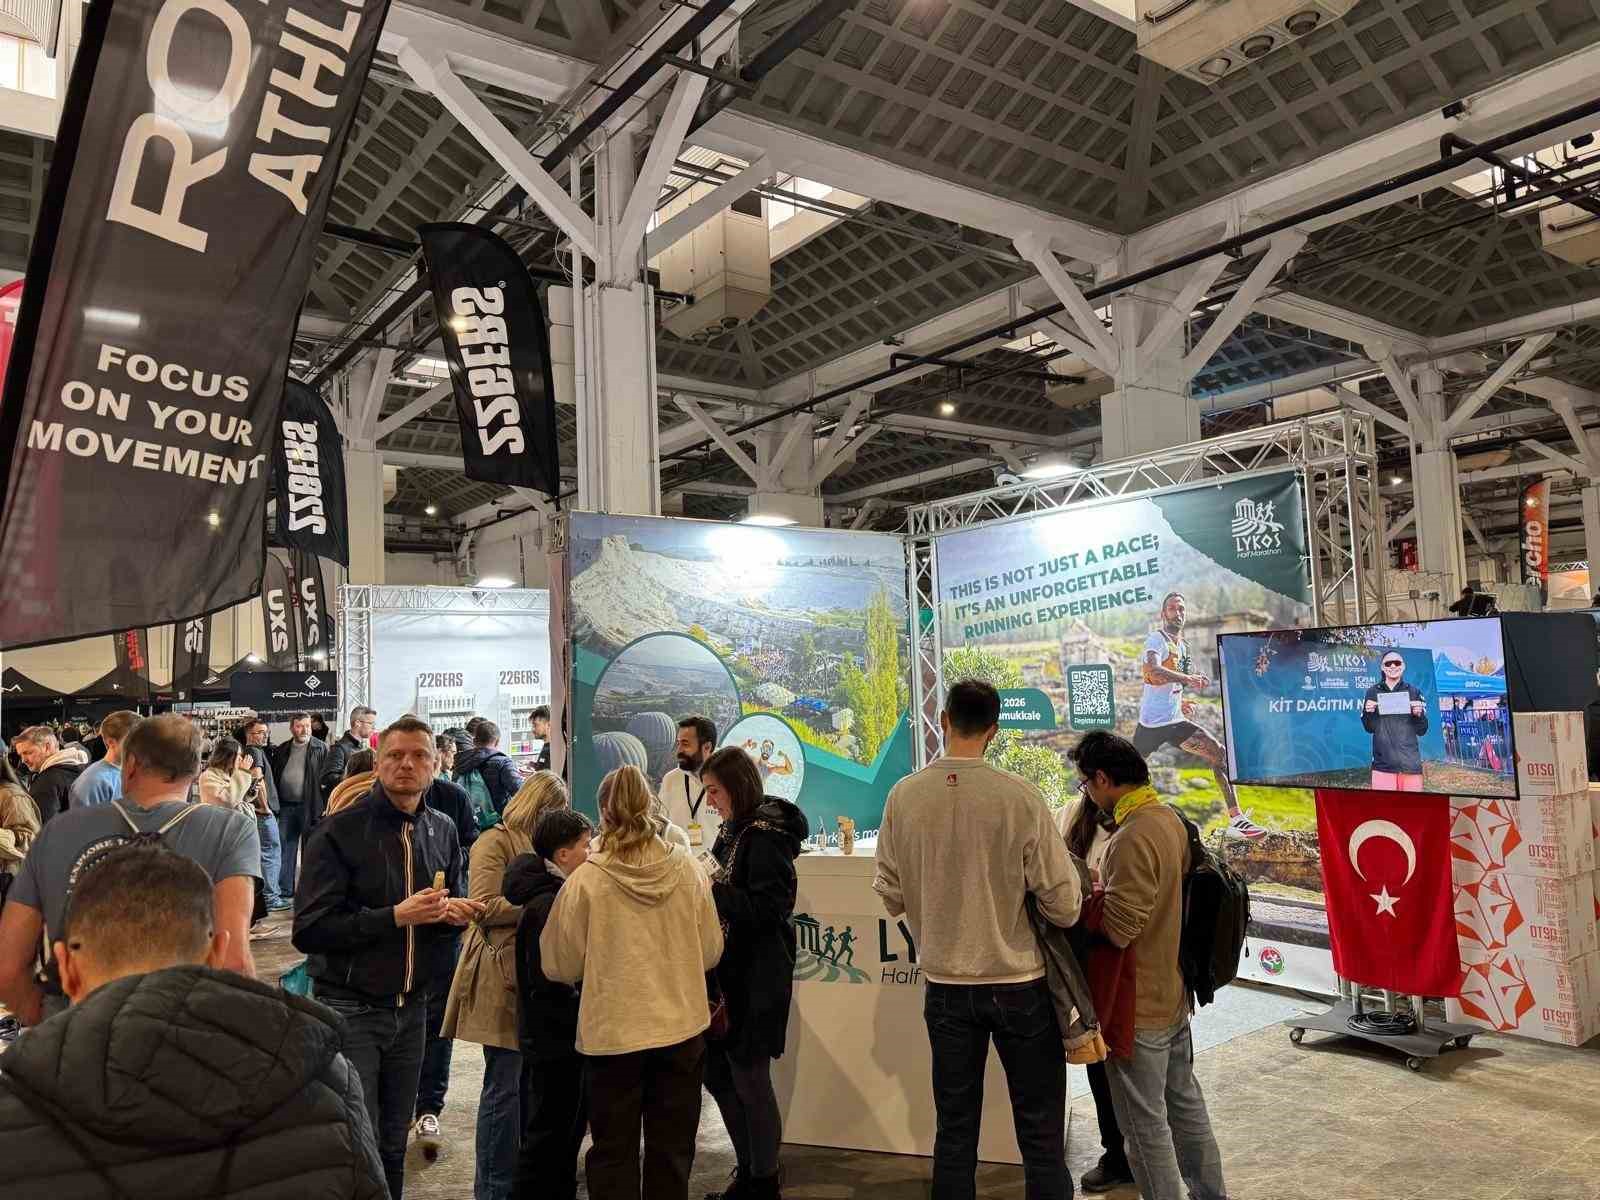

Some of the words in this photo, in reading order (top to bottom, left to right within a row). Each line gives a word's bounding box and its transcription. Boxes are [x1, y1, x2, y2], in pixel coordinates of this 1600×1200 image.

[105, 0, 268, 253] RO
[248, 0, 364, 215] ATHL
[96, 343, 250, 403] FOCUS
[60, 380, 132, 422] ON
[146, 399, 254, 447] YOUR
[26, 419, 267, 485] MOVEMENT
[950, 580, 981, 600] THIS
[984, 575, 999, 591] IS
[1002, 565, 1034, 586] NOT
[1039, 552, 1079, 577] JUST
[1084, 548, 1099, 566] A
[1101, 533, 1160, 561] RACE;
[1235, 532, 1281, 552] LYKOS
[954, 601, 981, 620] IT'S
[984, 595, 1006, 613] AN
[1009, 556, 1160, 607] UNFORGETTABLE
[963, 611, 1033, 639] RUNNING
[1037, 585, 1153, 623] EXPERIENCE.
[419, 671, 463, 688] 226ERS
[500, 669, 540, 685] 226ERS
[1332, 653, 1367, 667] LYKOS
[1003, 697, 1026, 708] 2026
[1268, 696, 1293, 713] KİT
[1296, 696, 1353, 712] DAĞITIM
[881, 967, 921, 985] Half
